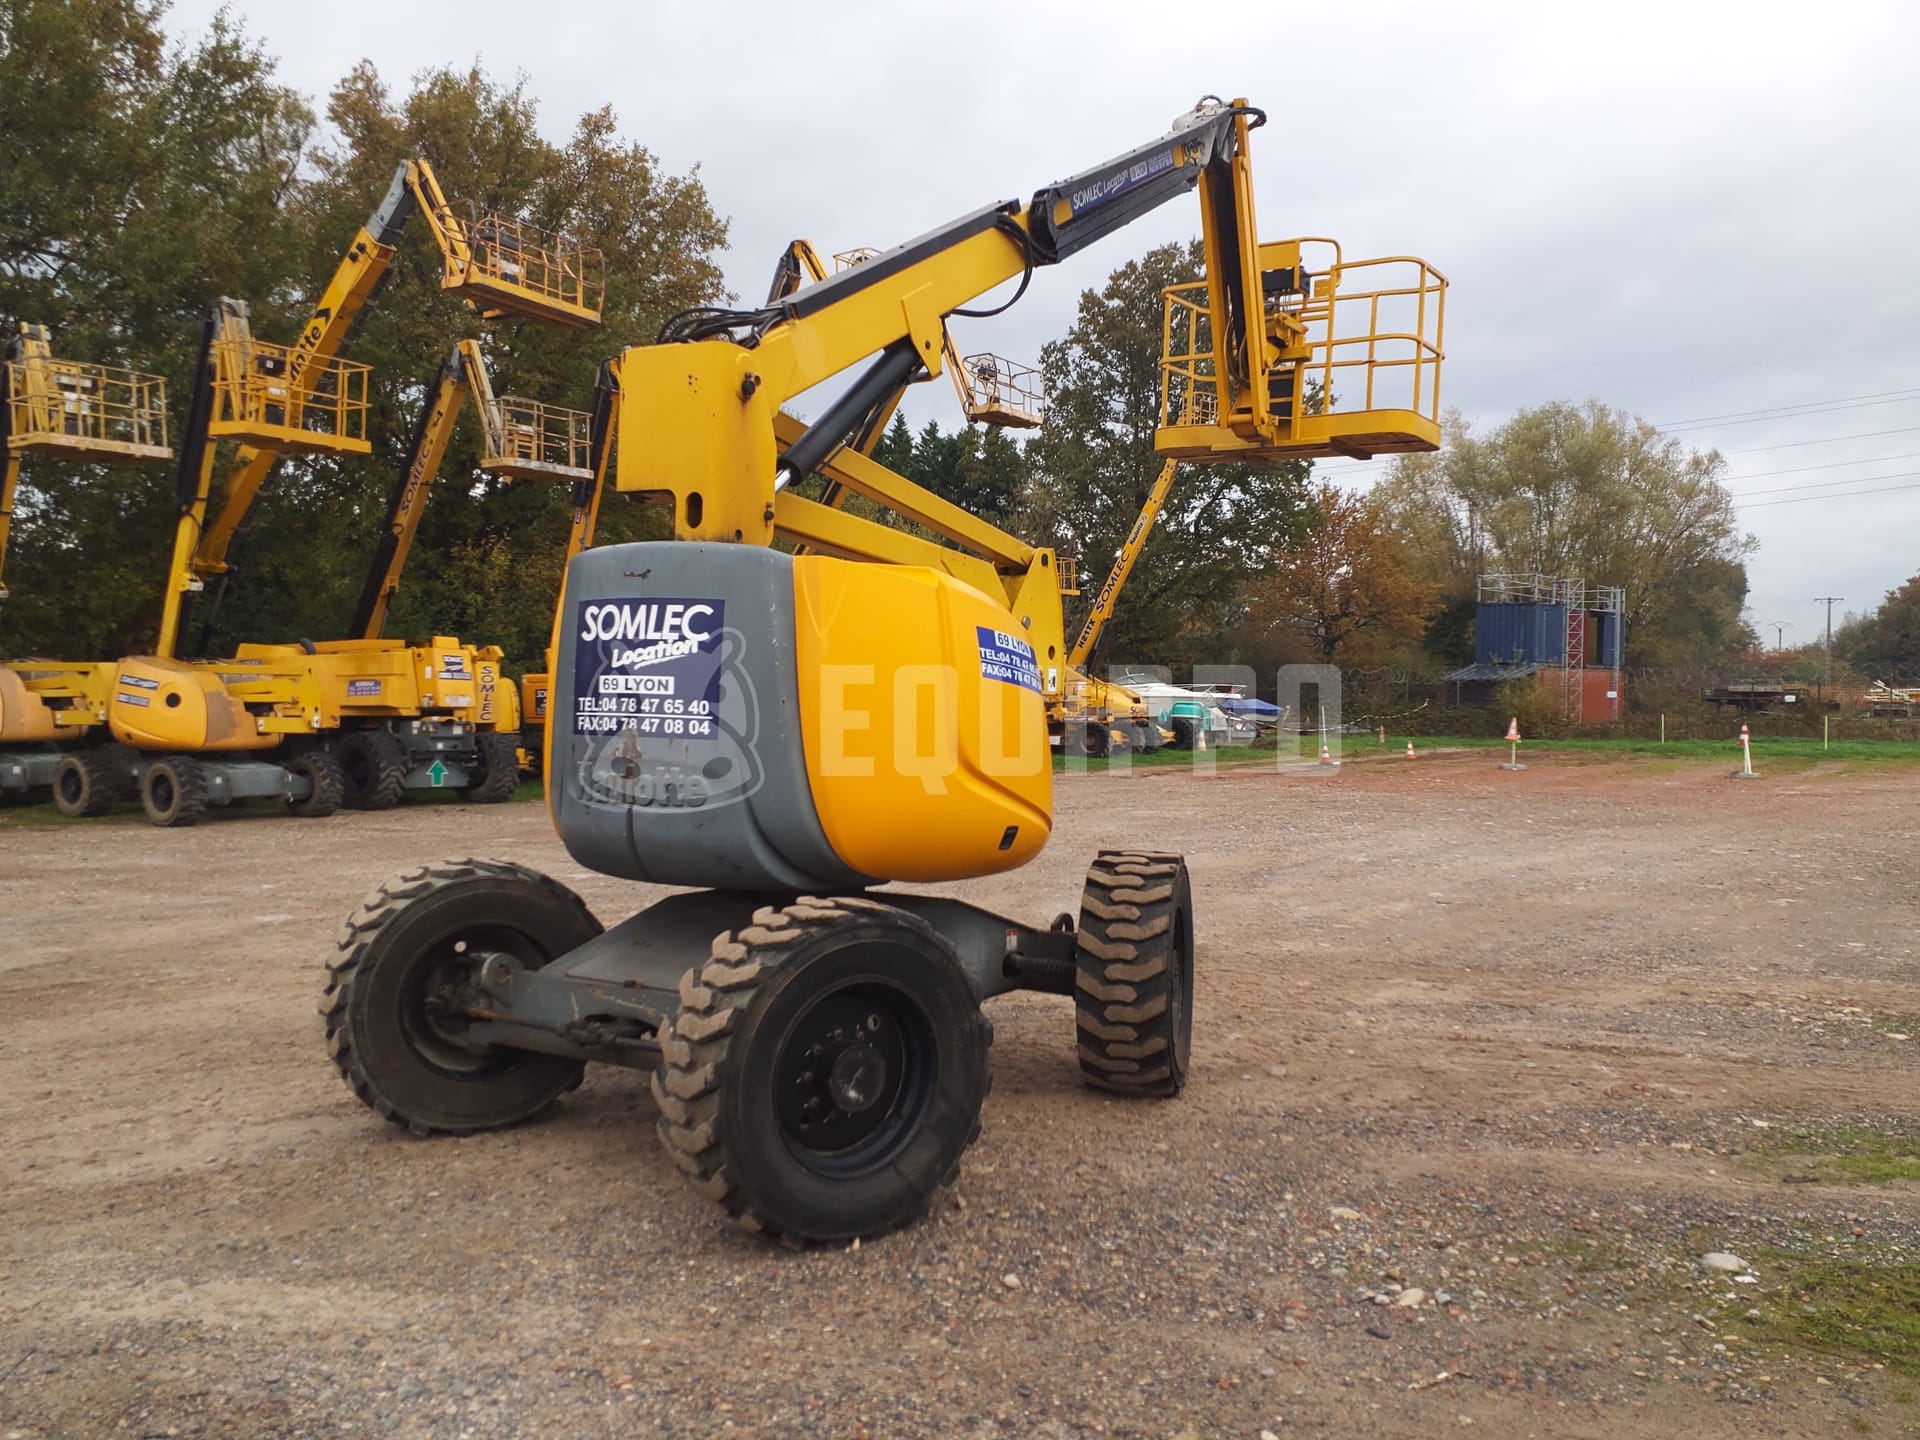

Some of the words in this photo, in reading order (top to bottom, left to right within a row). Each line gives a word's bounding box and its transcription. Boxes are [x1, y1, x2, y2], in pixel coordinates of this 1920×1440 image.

[1072, 181, 1104, 210] SOMLEC
[402, 444, 430, 516] SOMLEC
[1096, 550, 1130, 614] SOMLEC
[581, 604, 714, 641] SOMLEC
[1078, 619, 1096, 648] H21TX
[611, 639, 699, 668] Location
[997, 632, 1010, 647] 69
[479, 665, 495, 722] SOMLEC
[603, 678, 619, 690] 69
[625, 678, 669, 692] LYON
[578, 697, 618, 711] TEL:04
[620, 698, 637, 712] 78
[641, 699, 660, 713] 47
[664, 700, 684, 714] 65
[688, 701, 710, 715] 40
[578, 717, 618, 731] FAX:04
[621, 718, 638, 731] 78
[641, 719, 660, 733] 47
[664, 719, 685, 734] 08
[688, 721, 711, 735] 04
